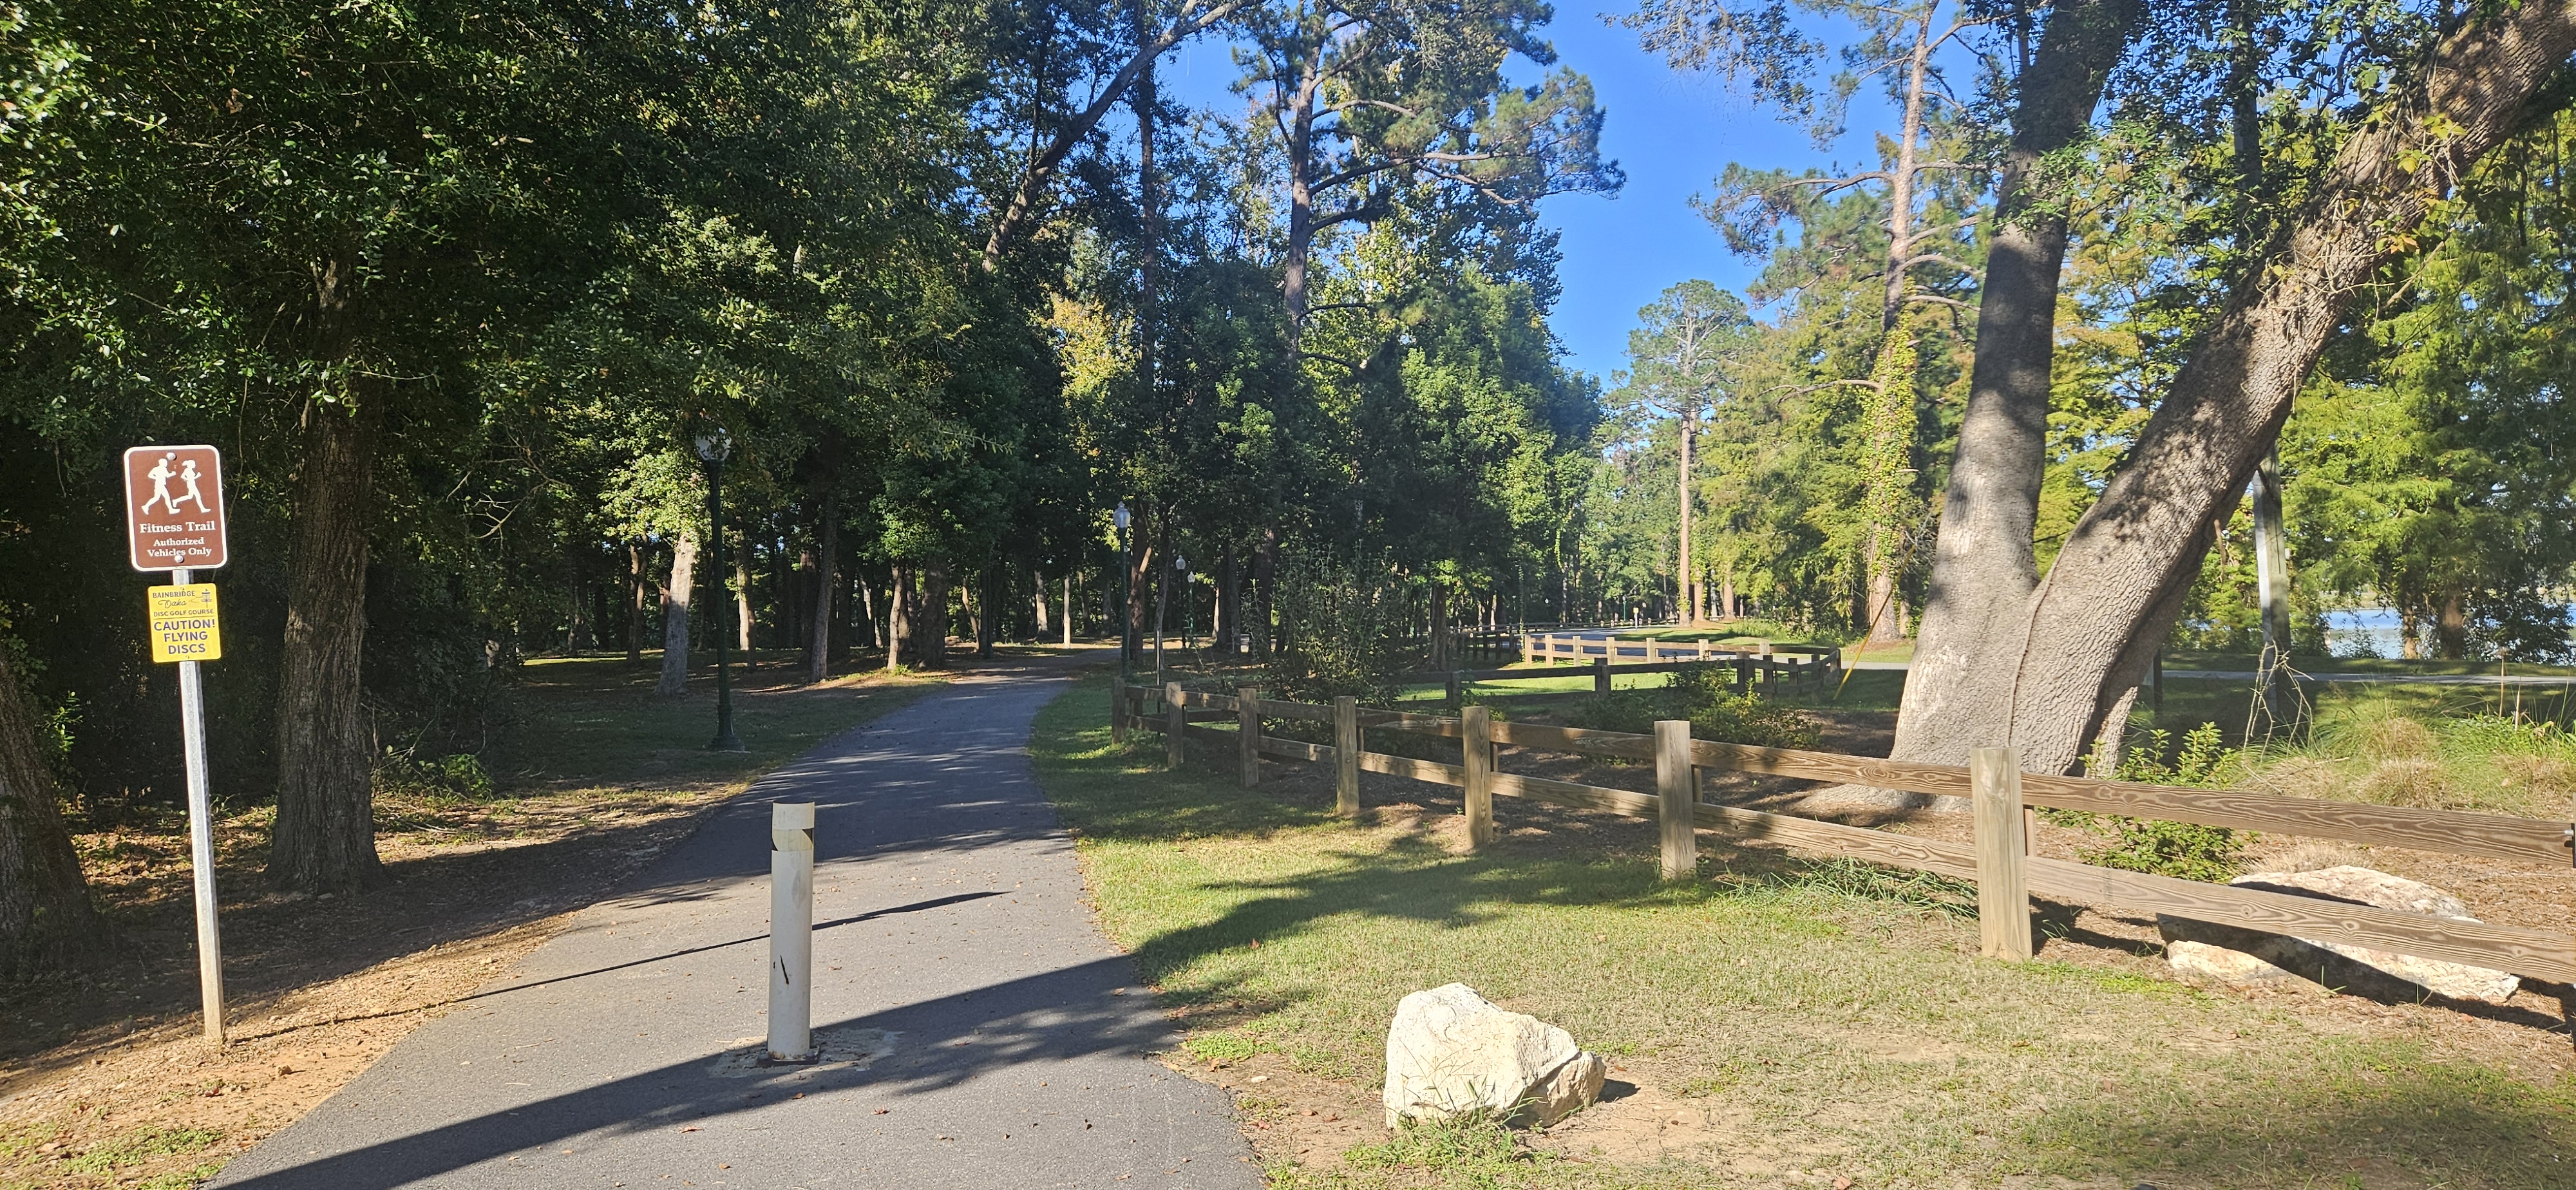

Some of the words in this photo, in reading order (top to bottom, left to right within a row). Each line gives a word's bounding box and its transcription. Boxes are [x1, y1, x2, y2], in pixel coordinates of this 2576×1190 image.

[140, 523, 183, 533] Fitness
[185, 520, 216, 531] Trail
[153, 537, 204, 547] Authorized
[147, 548, 186, 557] Vehicles
[188, 547, 212, 556] Only
[153, 590, 196, 599] BAINBRIDGE
[158, 599, 187, 609] Oaks
[154, 619, 215, 631] CAUTION!
[164, 631, 208, 642] FLYING
[168, 643, 206, 654] DISCS
